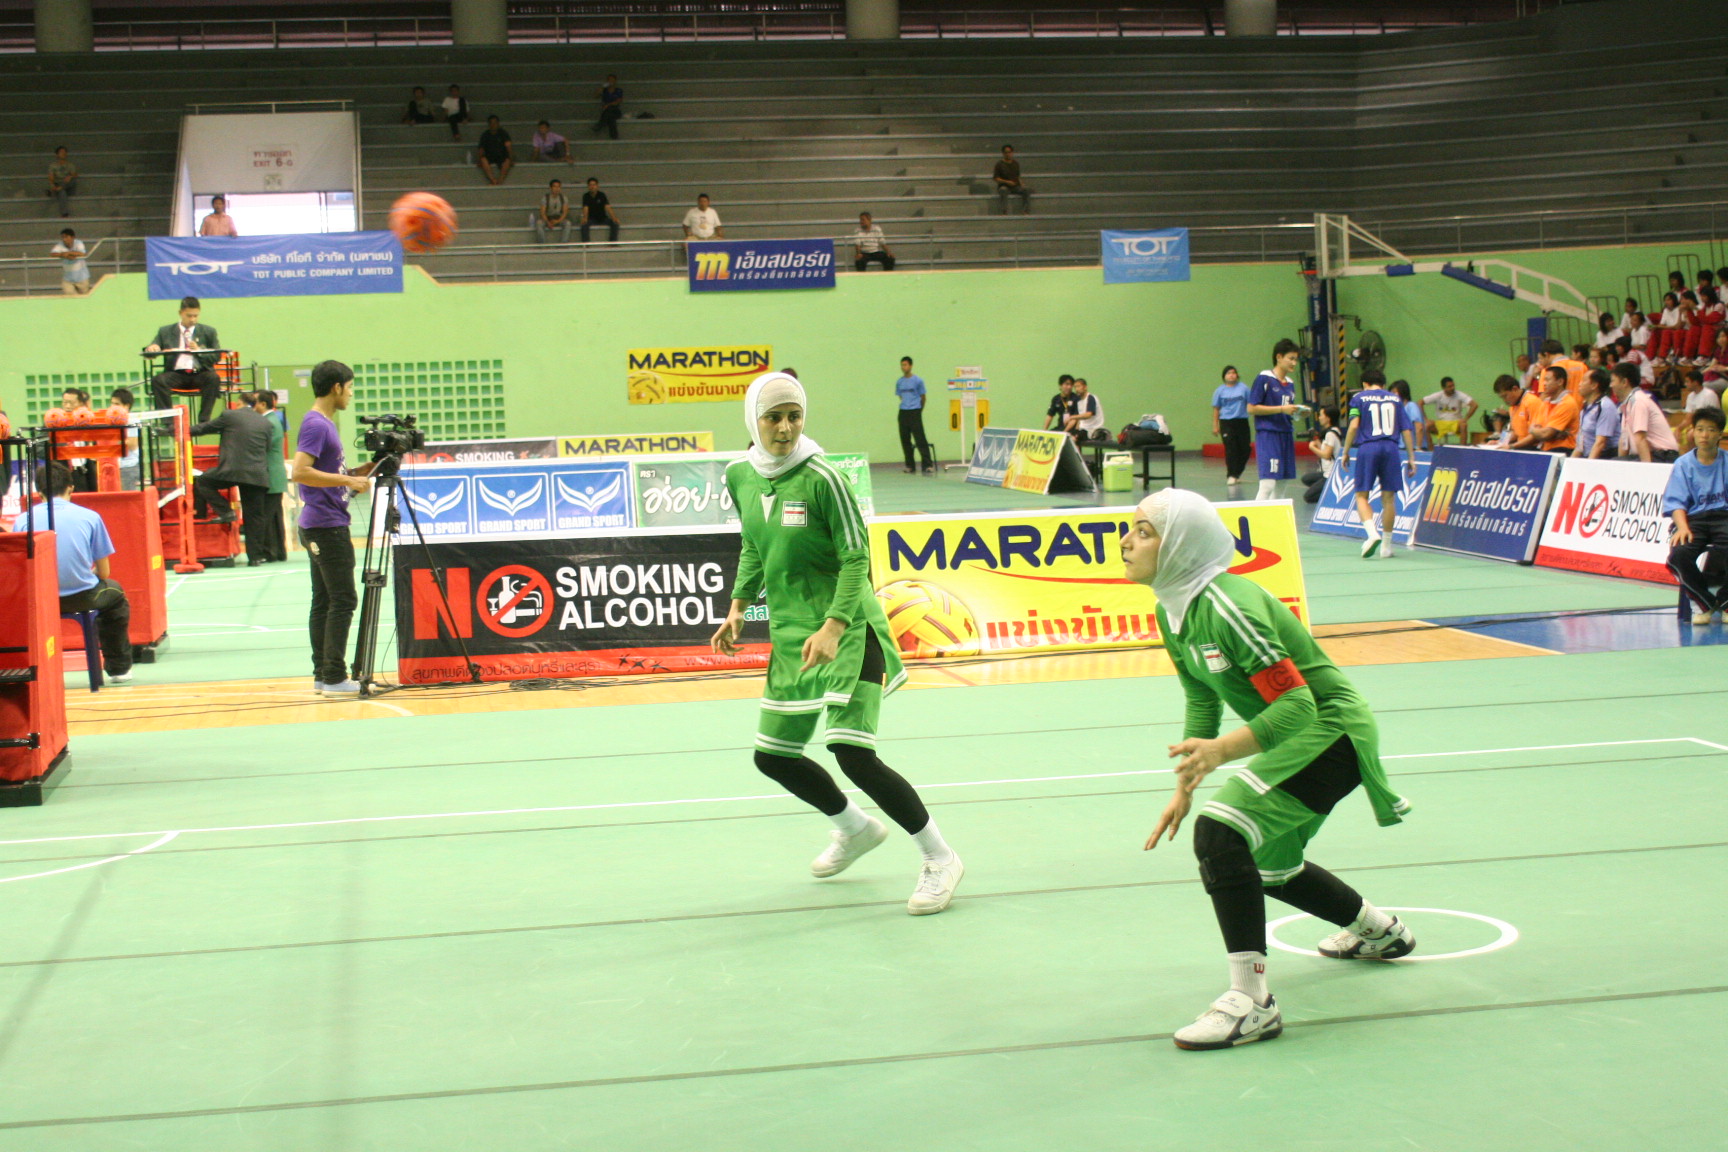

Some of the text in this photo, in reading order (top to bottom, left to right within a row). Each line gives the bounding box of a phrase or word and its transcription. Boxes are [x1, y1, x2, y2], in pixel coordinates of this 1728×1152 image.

[1111, 236, 1180, 256] TOT
[252, 253, 282, 264] บริษัท
[316, 251, 345, 263] จำกัด
[735, 250, 832, 270] เอ็มสปอร์ต
[154, 260, 245, 275] TOT
[253, 266, 394, 279] TOT PUBLIC COMPANY LIMITED
[629, 350, 769, 369] MARATHON
[669, 381, 750, 398] แข่งขันนานา
[1360, 395, 1400, 403] THAILAND
[1368, 403, 1396, 436] 10
[565, 436, 698, 455] MARATHON
[454, 451, 515, 463] SMOKING
[1455, 470, 1541, 514] เอ็มสปอร์ต
[1610, 489, 1664, 517] SMOKIN
[401, 521, 468, 535] GRND SPORT
[479, 518, 546, 532] GRAND SPORT
[558, 515, 625, 529] GRAND SPORT
[1602, 516, 1661, 544] ALCOHOL
[887, 516, 1253, 571] MARATN
[556, 562, 724, 599] SMOKING
[558, 596, 726, 631] ALCOHOL
